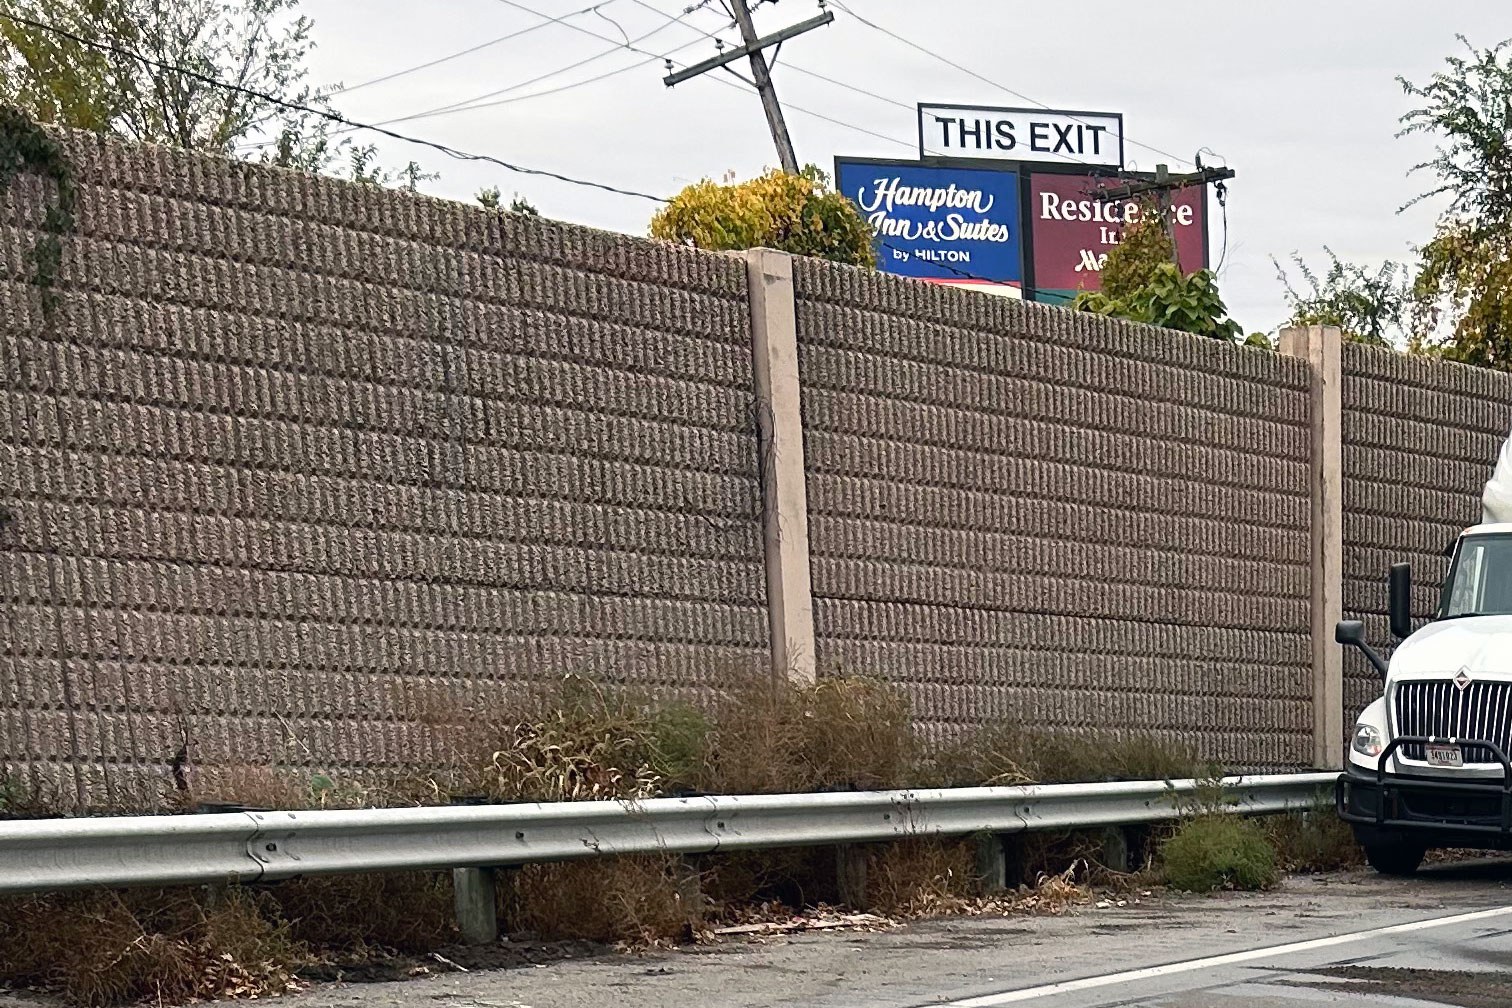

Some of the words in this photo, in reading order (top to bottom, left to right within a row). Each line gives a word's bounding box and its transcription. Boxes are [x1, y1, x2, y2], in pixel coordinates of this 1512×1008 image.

[935, 116, 1017, 151] THIS
[1029, 122, 1107, 155] EXIT
[858, 177, 994, 213] Hampton
[868, 211, 922, 240] Inn
[923, 221, 941, 242] &
[938, 213, 1009, 242] Suites
[893, 249, 909, 262] by
[915, 249, 970, 262] HILTON
